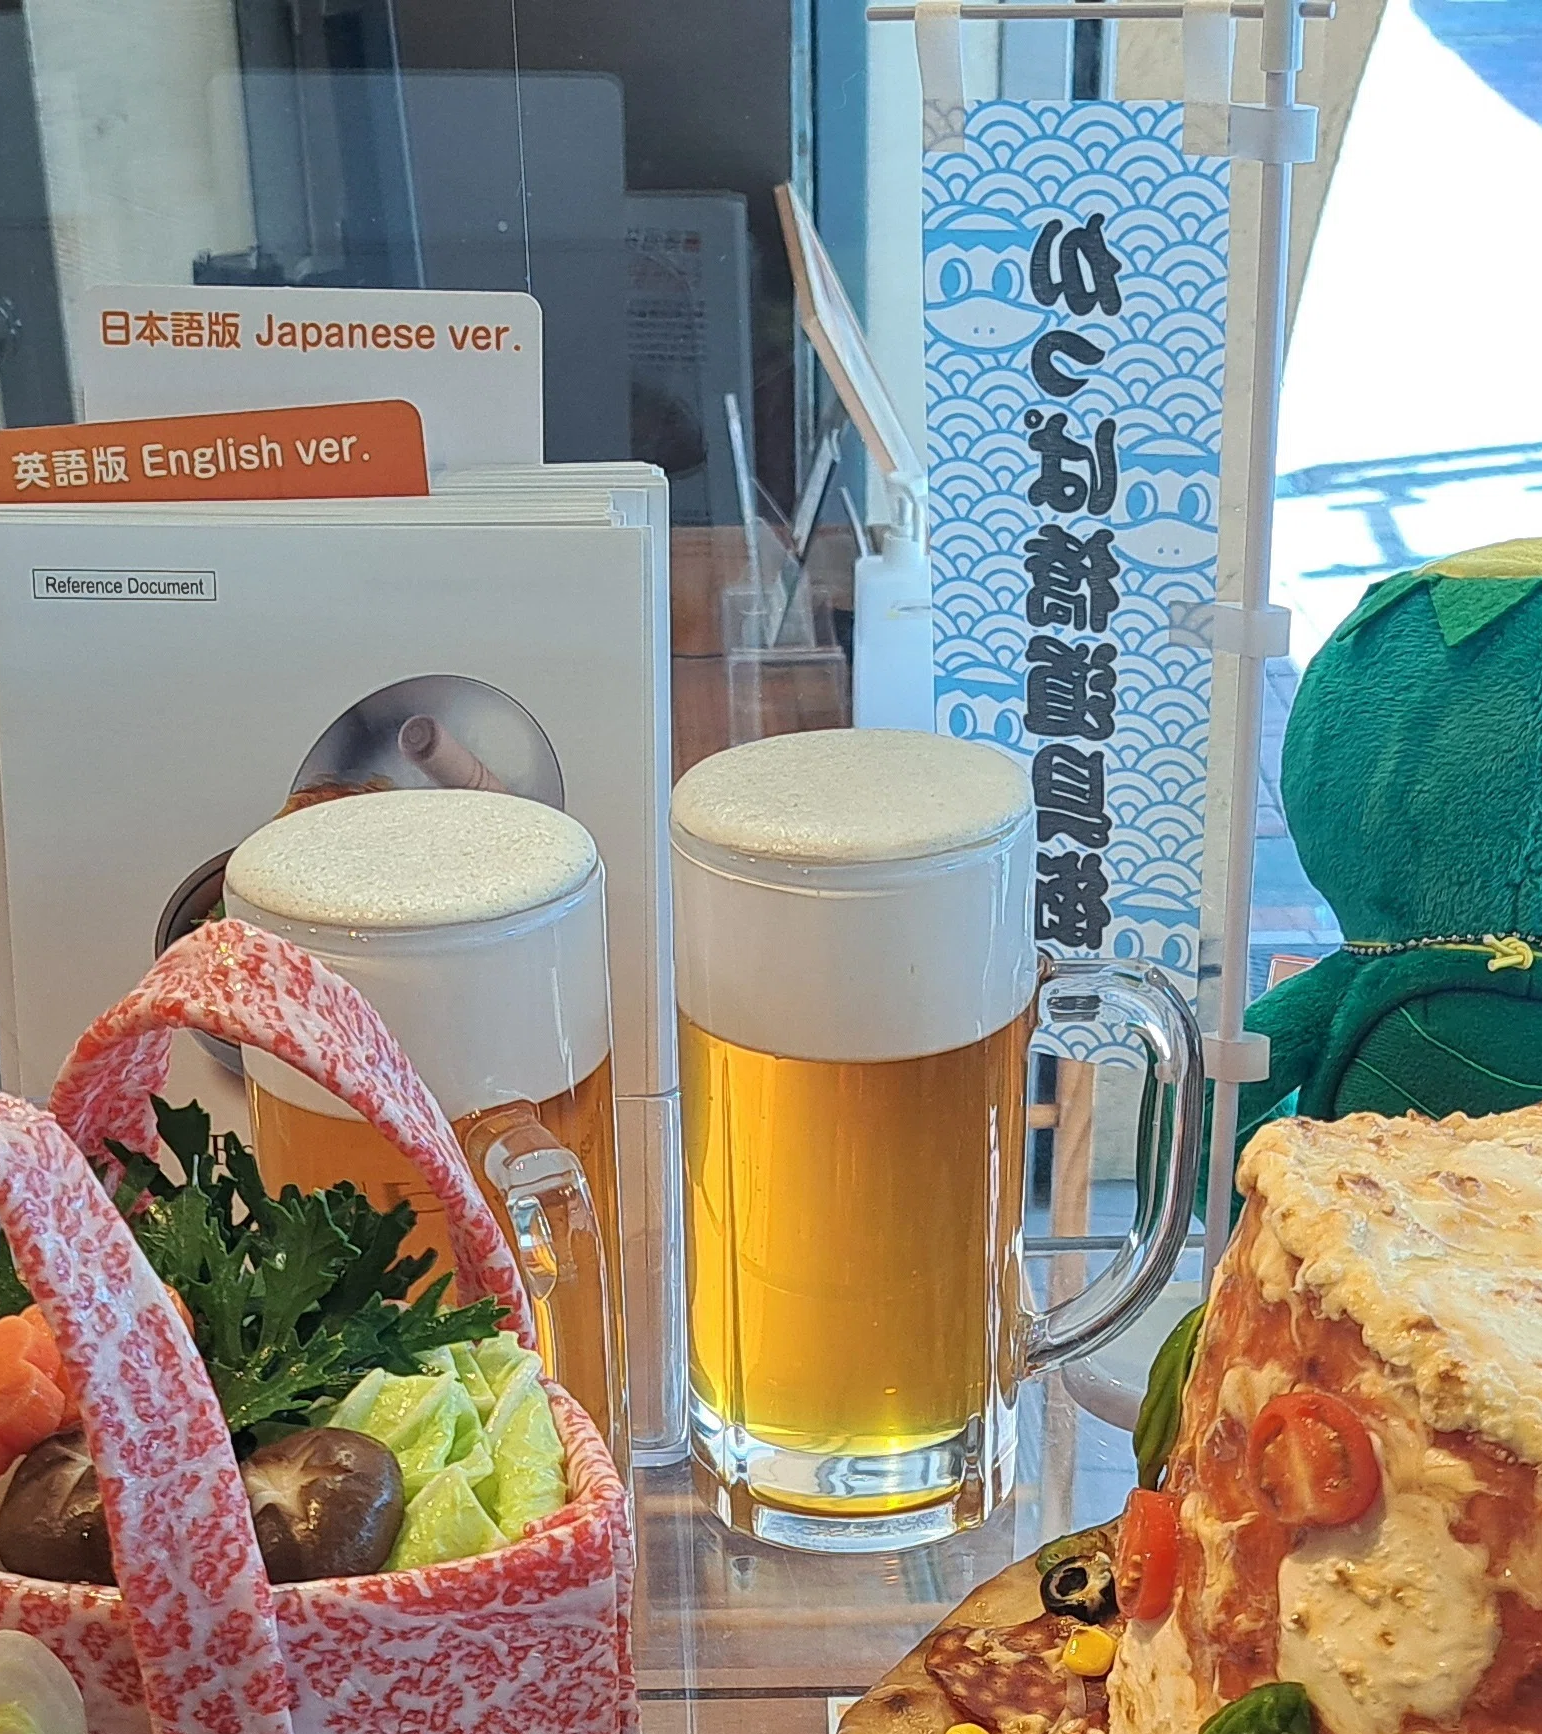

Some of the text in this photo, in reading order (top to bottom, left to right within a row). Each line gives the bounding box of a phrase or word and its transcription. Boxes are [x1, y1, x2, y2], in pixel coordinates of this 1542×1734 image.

[100, 310, 523, 353] 日本語版 Japanese ver.
[11, 432, 371, 490] 英語版 English ver.
[44, 576, 205, 597] Reference Document
